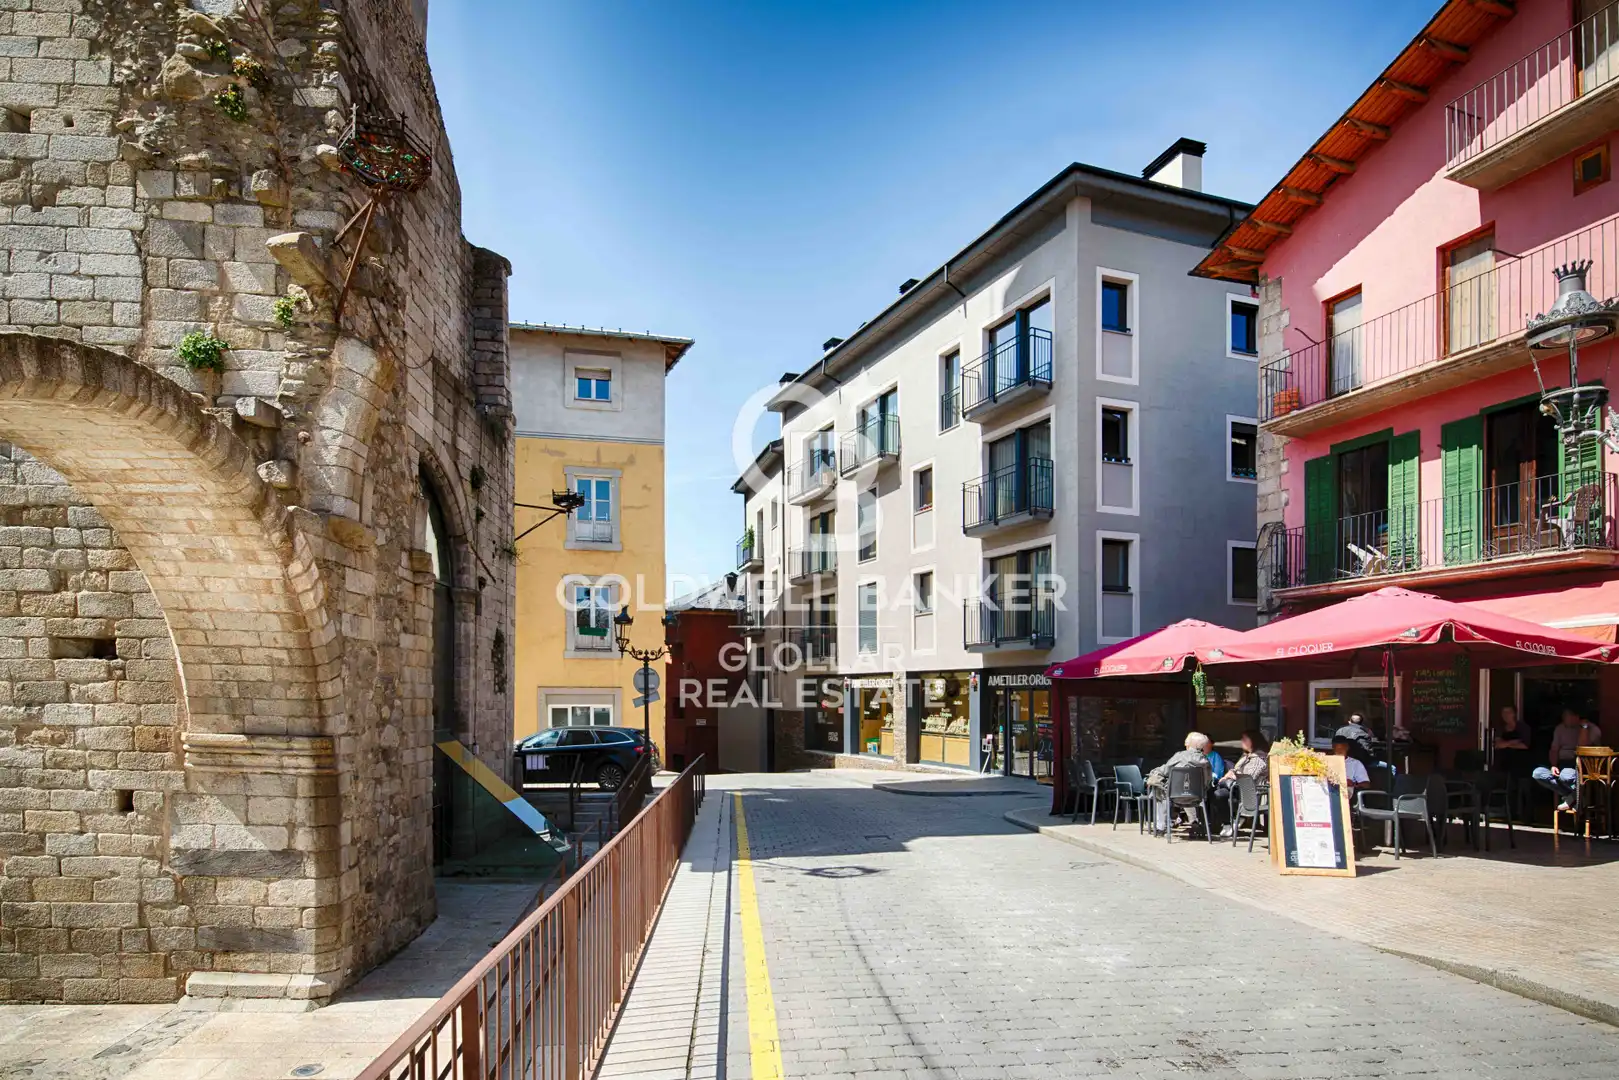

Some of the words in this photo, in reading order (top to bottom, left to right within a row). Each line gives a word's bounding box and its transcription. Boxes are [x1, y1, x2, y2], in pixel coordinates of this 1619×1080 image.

[1287, 642, 1334, 655] CLOQUER
[1524, 642, 1557, 655] CLOQUER
[988, 675, 1028, 687] AMETLLER
